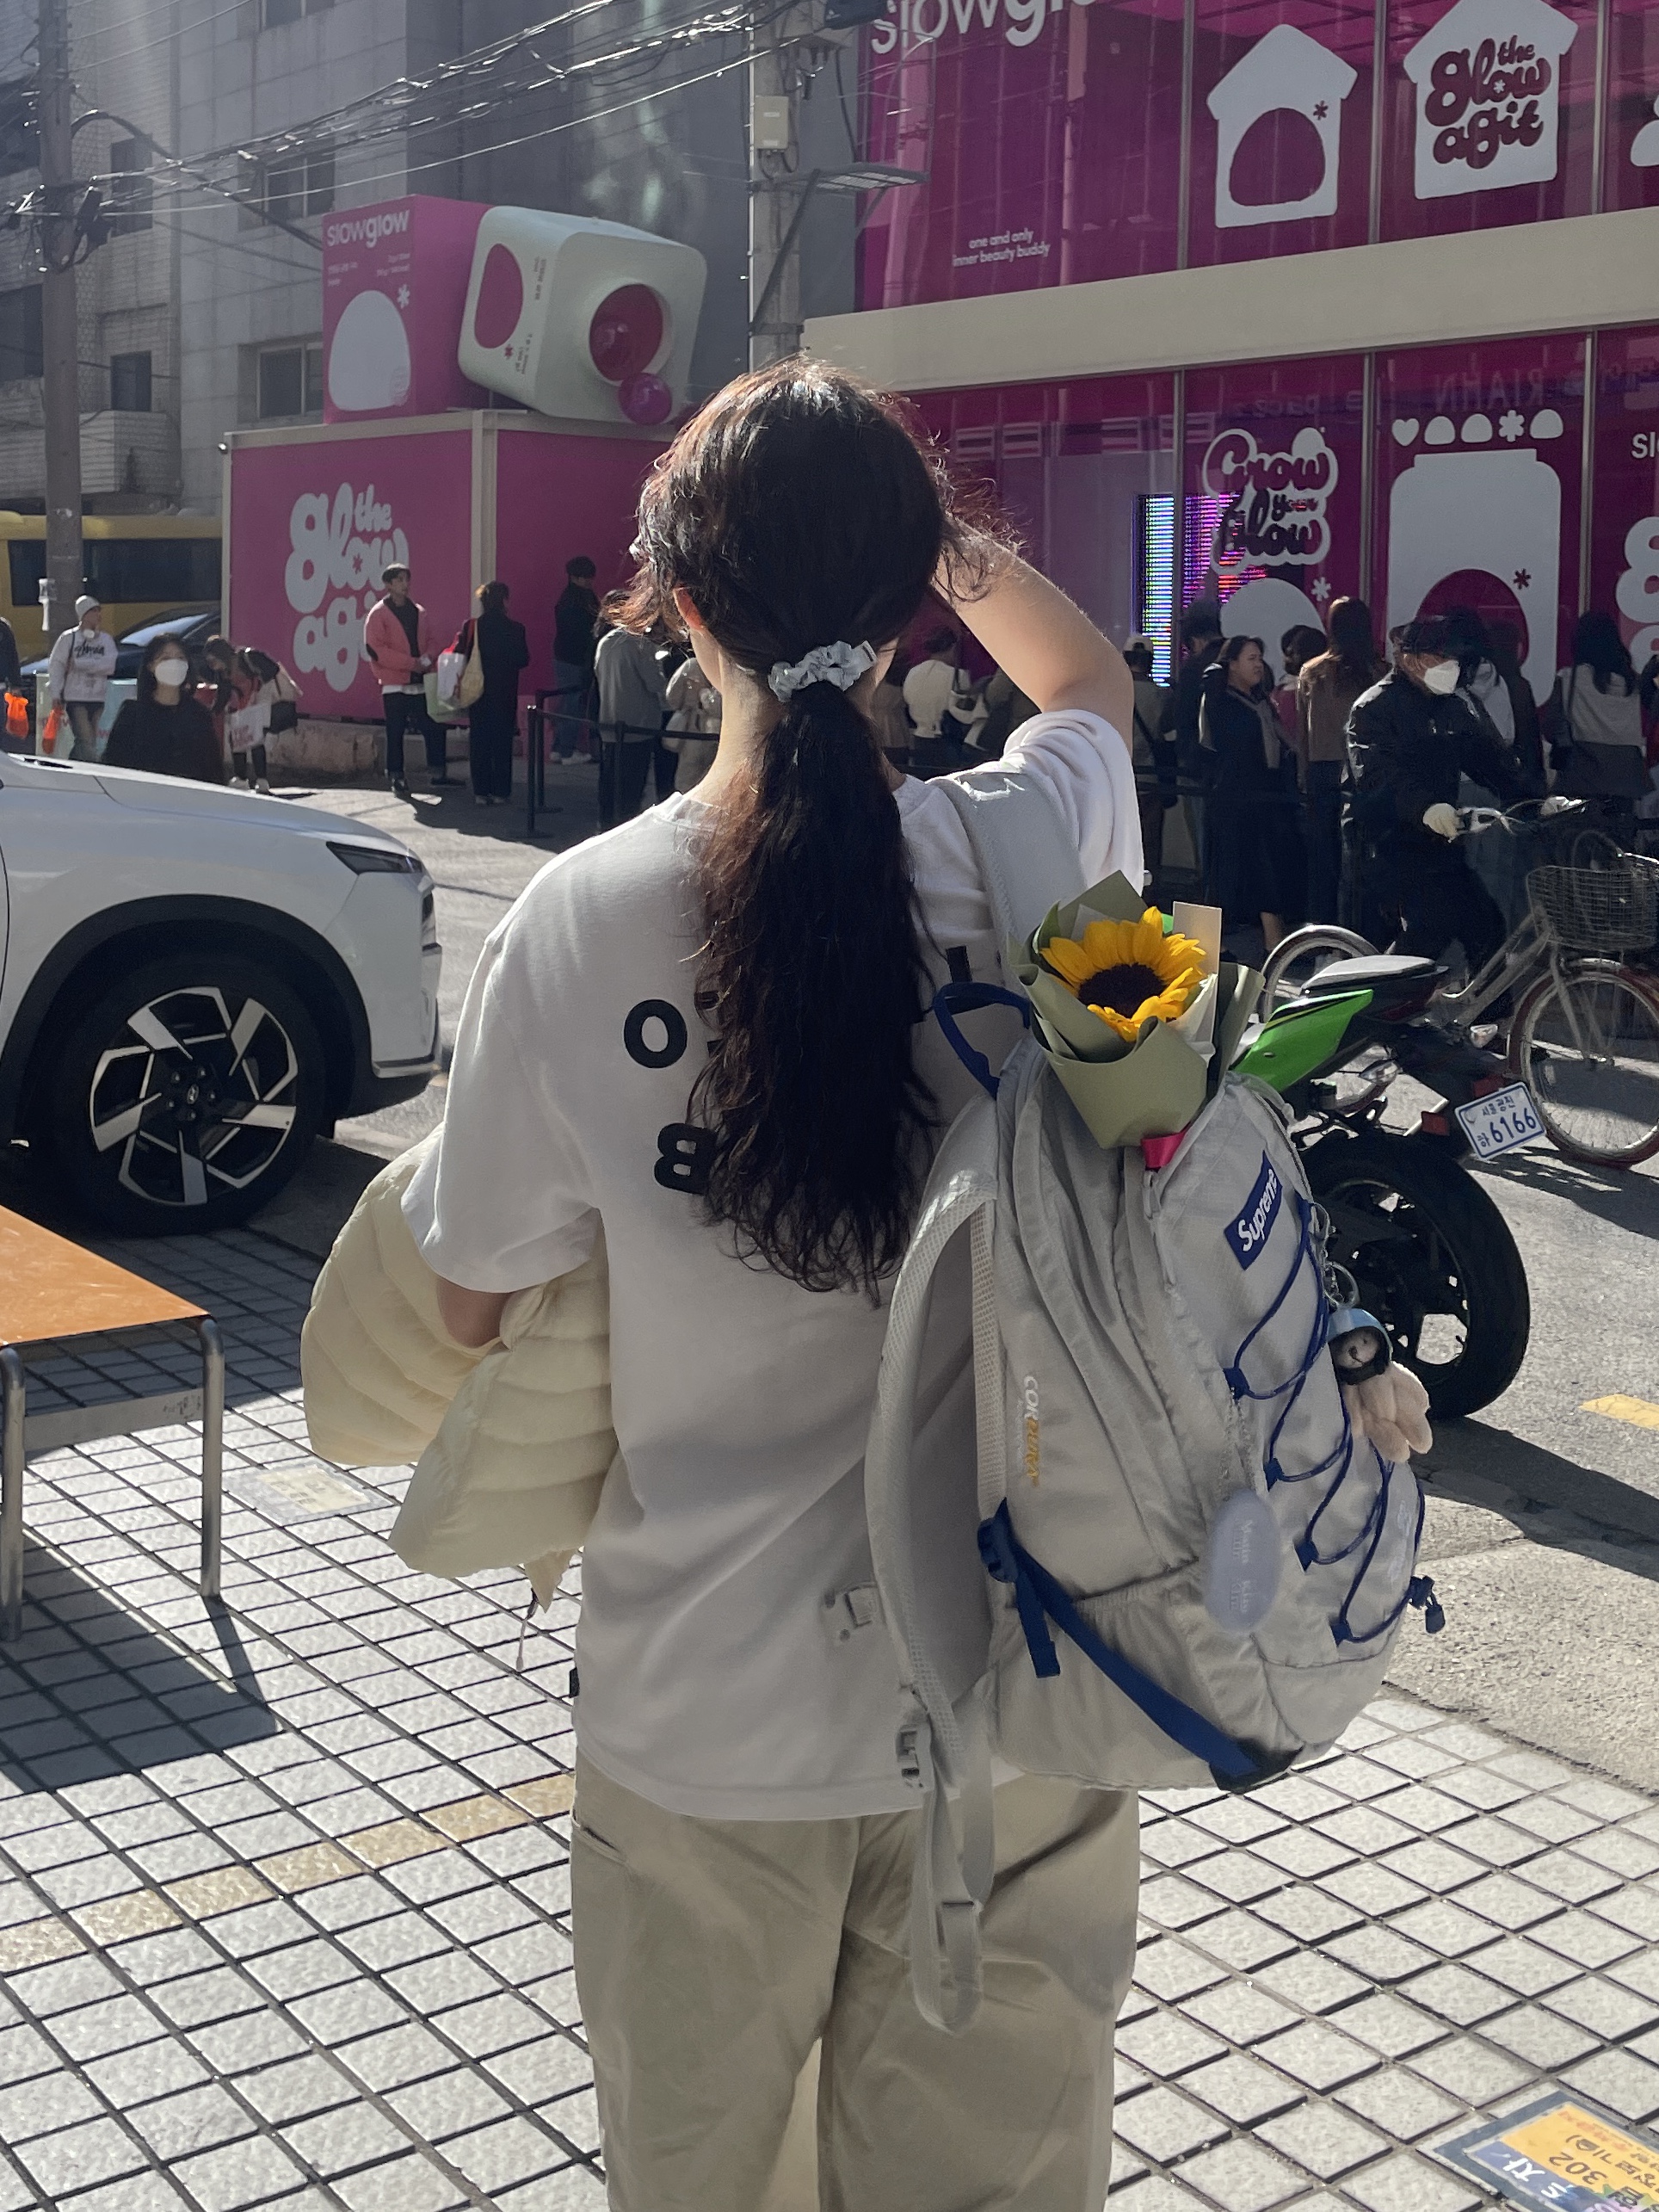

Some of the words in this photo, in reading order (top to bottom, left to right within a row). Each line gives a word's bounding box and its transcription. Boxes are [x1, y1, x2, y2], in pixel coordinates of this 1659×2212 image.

[1497, 35, 1536, 65] the
[1424, 37, 1551, 127] glow
[1433, 101, 1545, 170] agit
[326, 209, 410, 249] slowglow
[968, 238, 989, 249] one
[989, 230, 1010, 245] and
[1011, 227, 1034, 244] only
[952, 254, 979, 267] inner
[979, 248, 1015, 263] beauty
[1016, 241, 1051, 257] buddy
[354, 484, 392, 533] the
[1489, 1108, 1537, 1144] 6166
[1237, 1168, 1279, 1252] Supreme
[1549, 2152, 1608, 2184] 302
